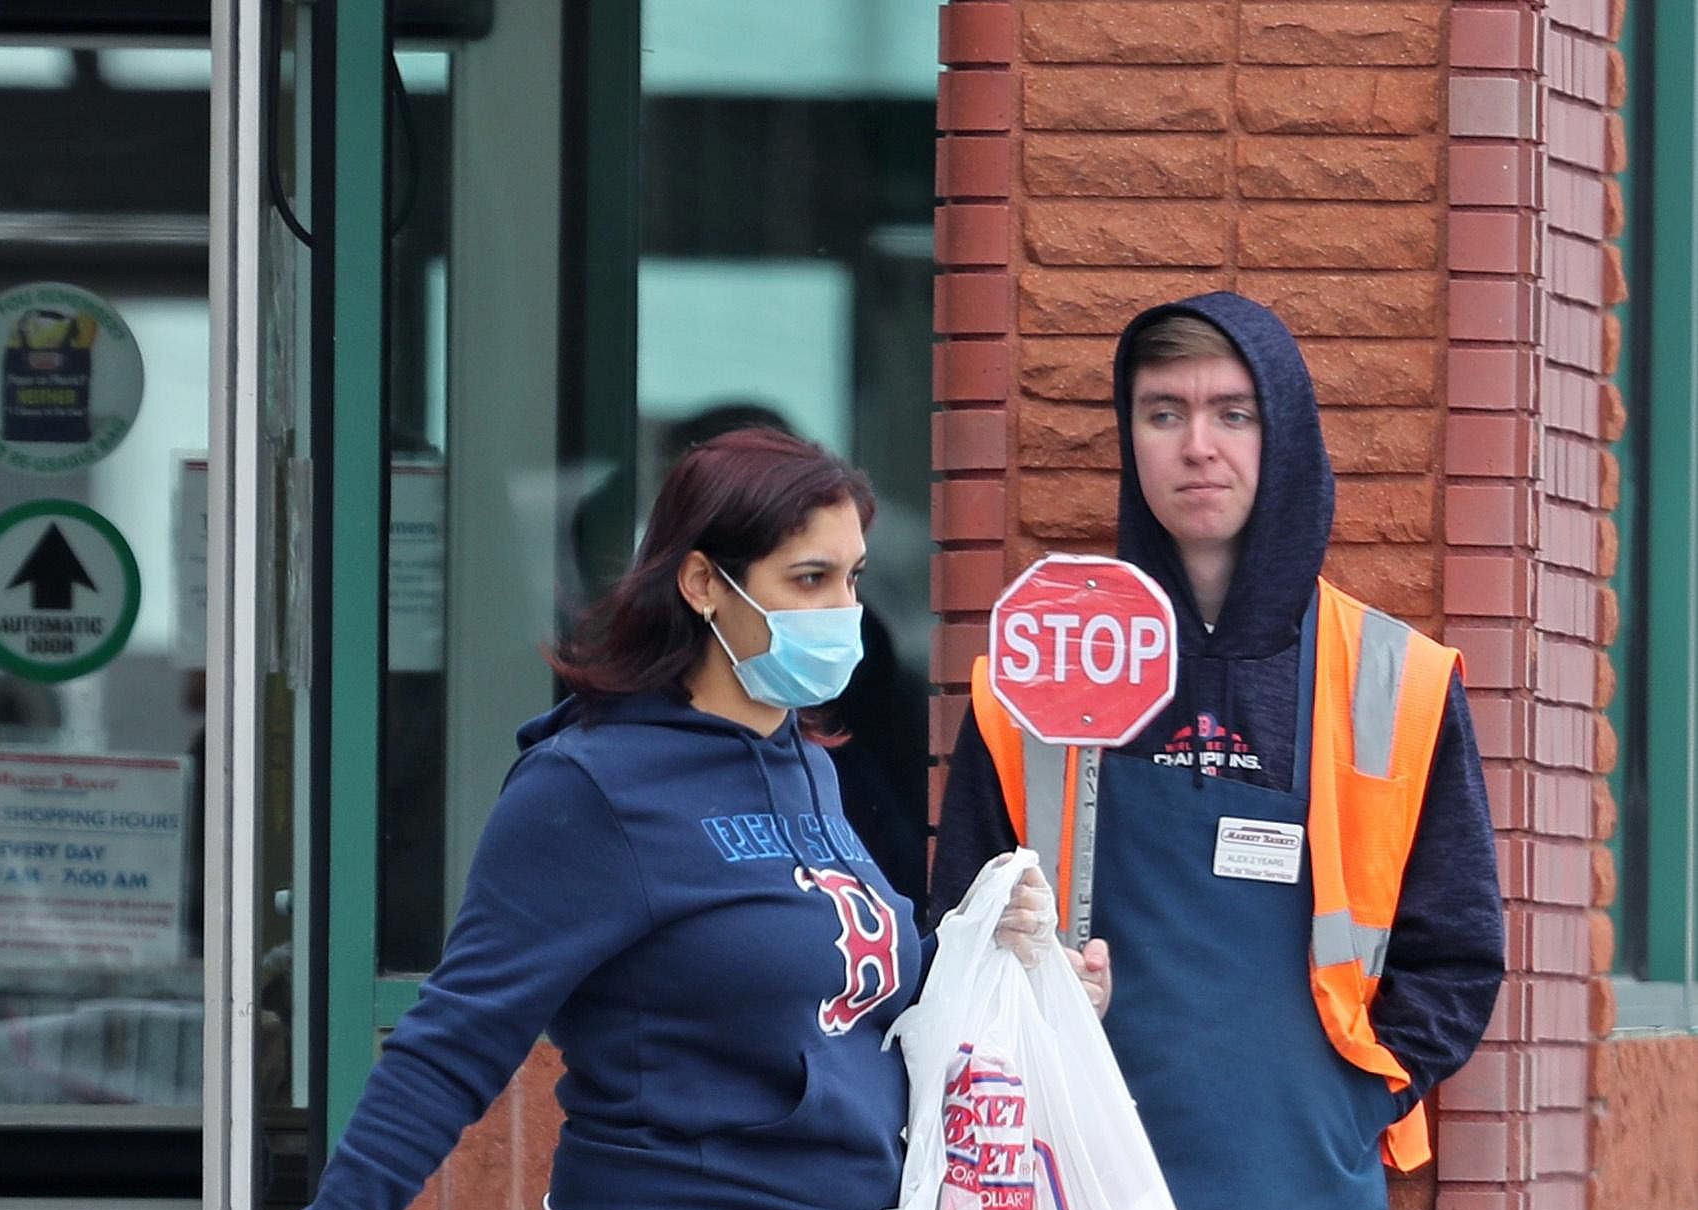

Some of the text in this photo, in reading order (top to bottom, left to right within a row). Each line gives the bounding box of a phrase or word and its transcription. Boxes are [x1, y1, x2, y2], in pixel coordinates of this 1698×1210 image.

[0, 615, 102, 635] AUTOMATIC
[25, 636, 75, 655] DOOR
[1002, 612, 1167, 685] STOP
[1152, 751, 1262, 770] CHAPINS.
[3, 804, 105, 826] SHOPPING
[109, 811, 178, 829] HOURS
[798, 813, 874, 863] SO
[64, 843, 106, 860] DAY
[112, 871, 148, 889] AM
[980, 1189, 1030, 1208] OLLAR"
